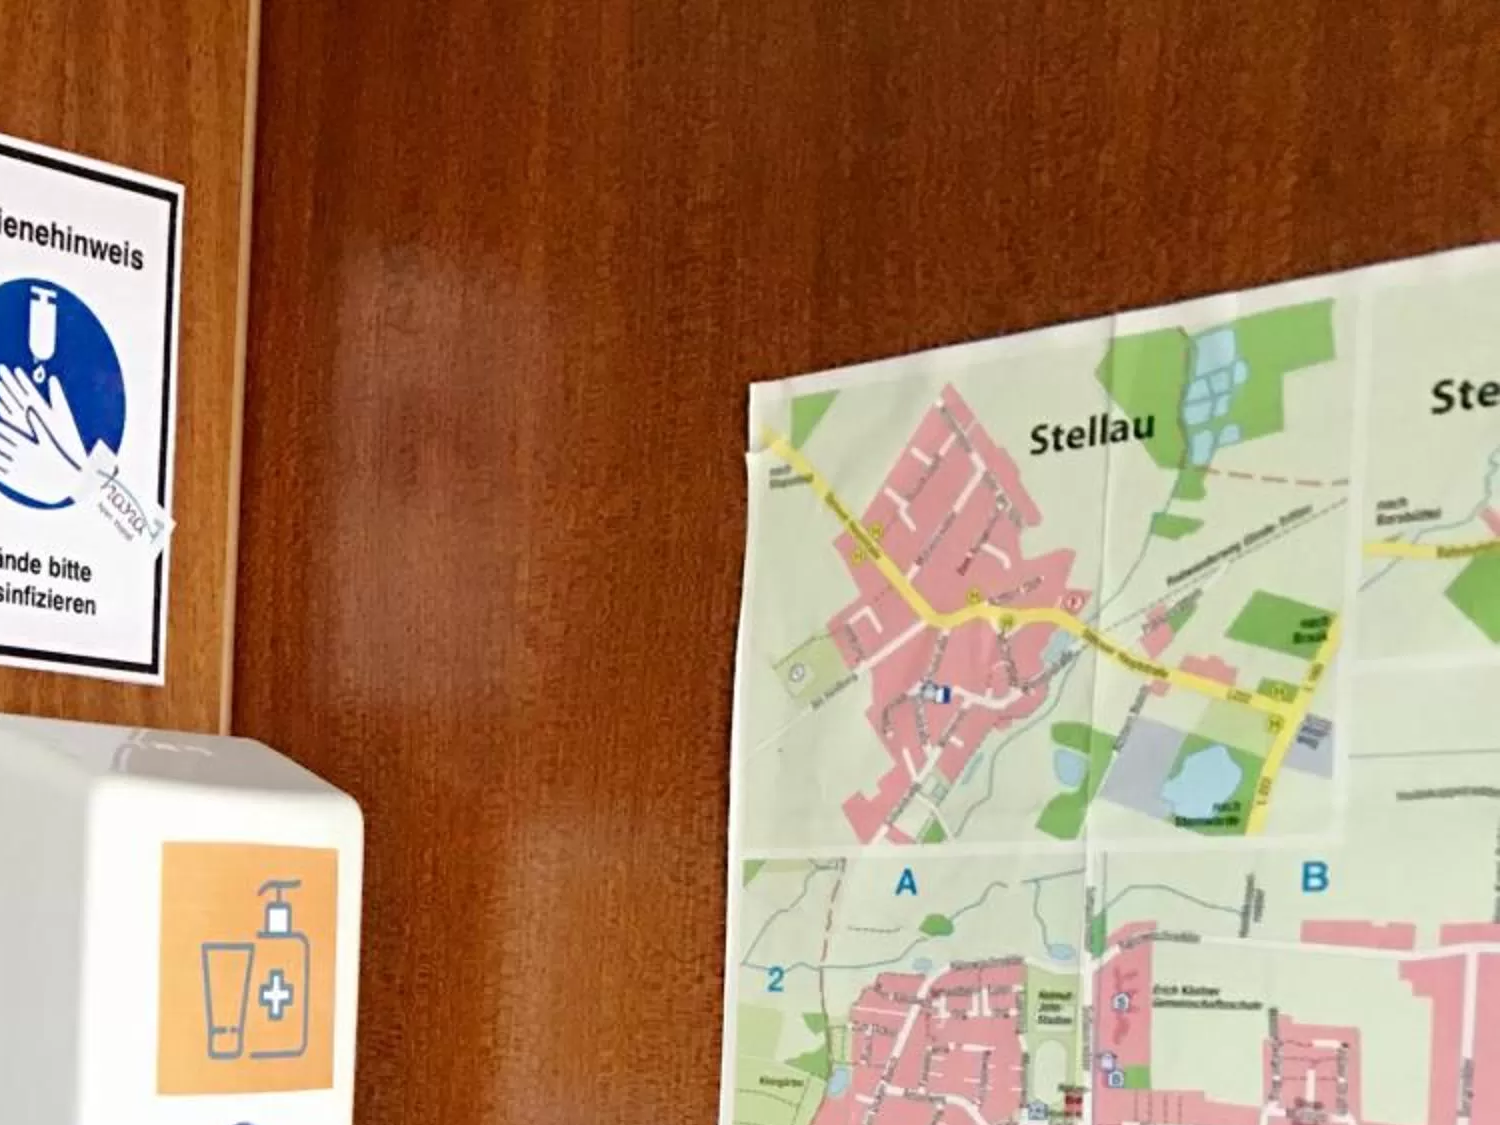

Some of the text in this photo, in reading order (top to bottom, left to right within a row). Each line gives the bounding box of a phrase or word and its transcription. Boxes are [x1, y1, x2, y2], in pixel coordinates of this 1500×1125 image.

[1030, 414, 1156, 455] Stellau
[48, 553, 92, 583] bitte
[895, 868, 917, 896] A
[1301, 861, 1330, 892] B
[767, 966, 785, 992] 2
